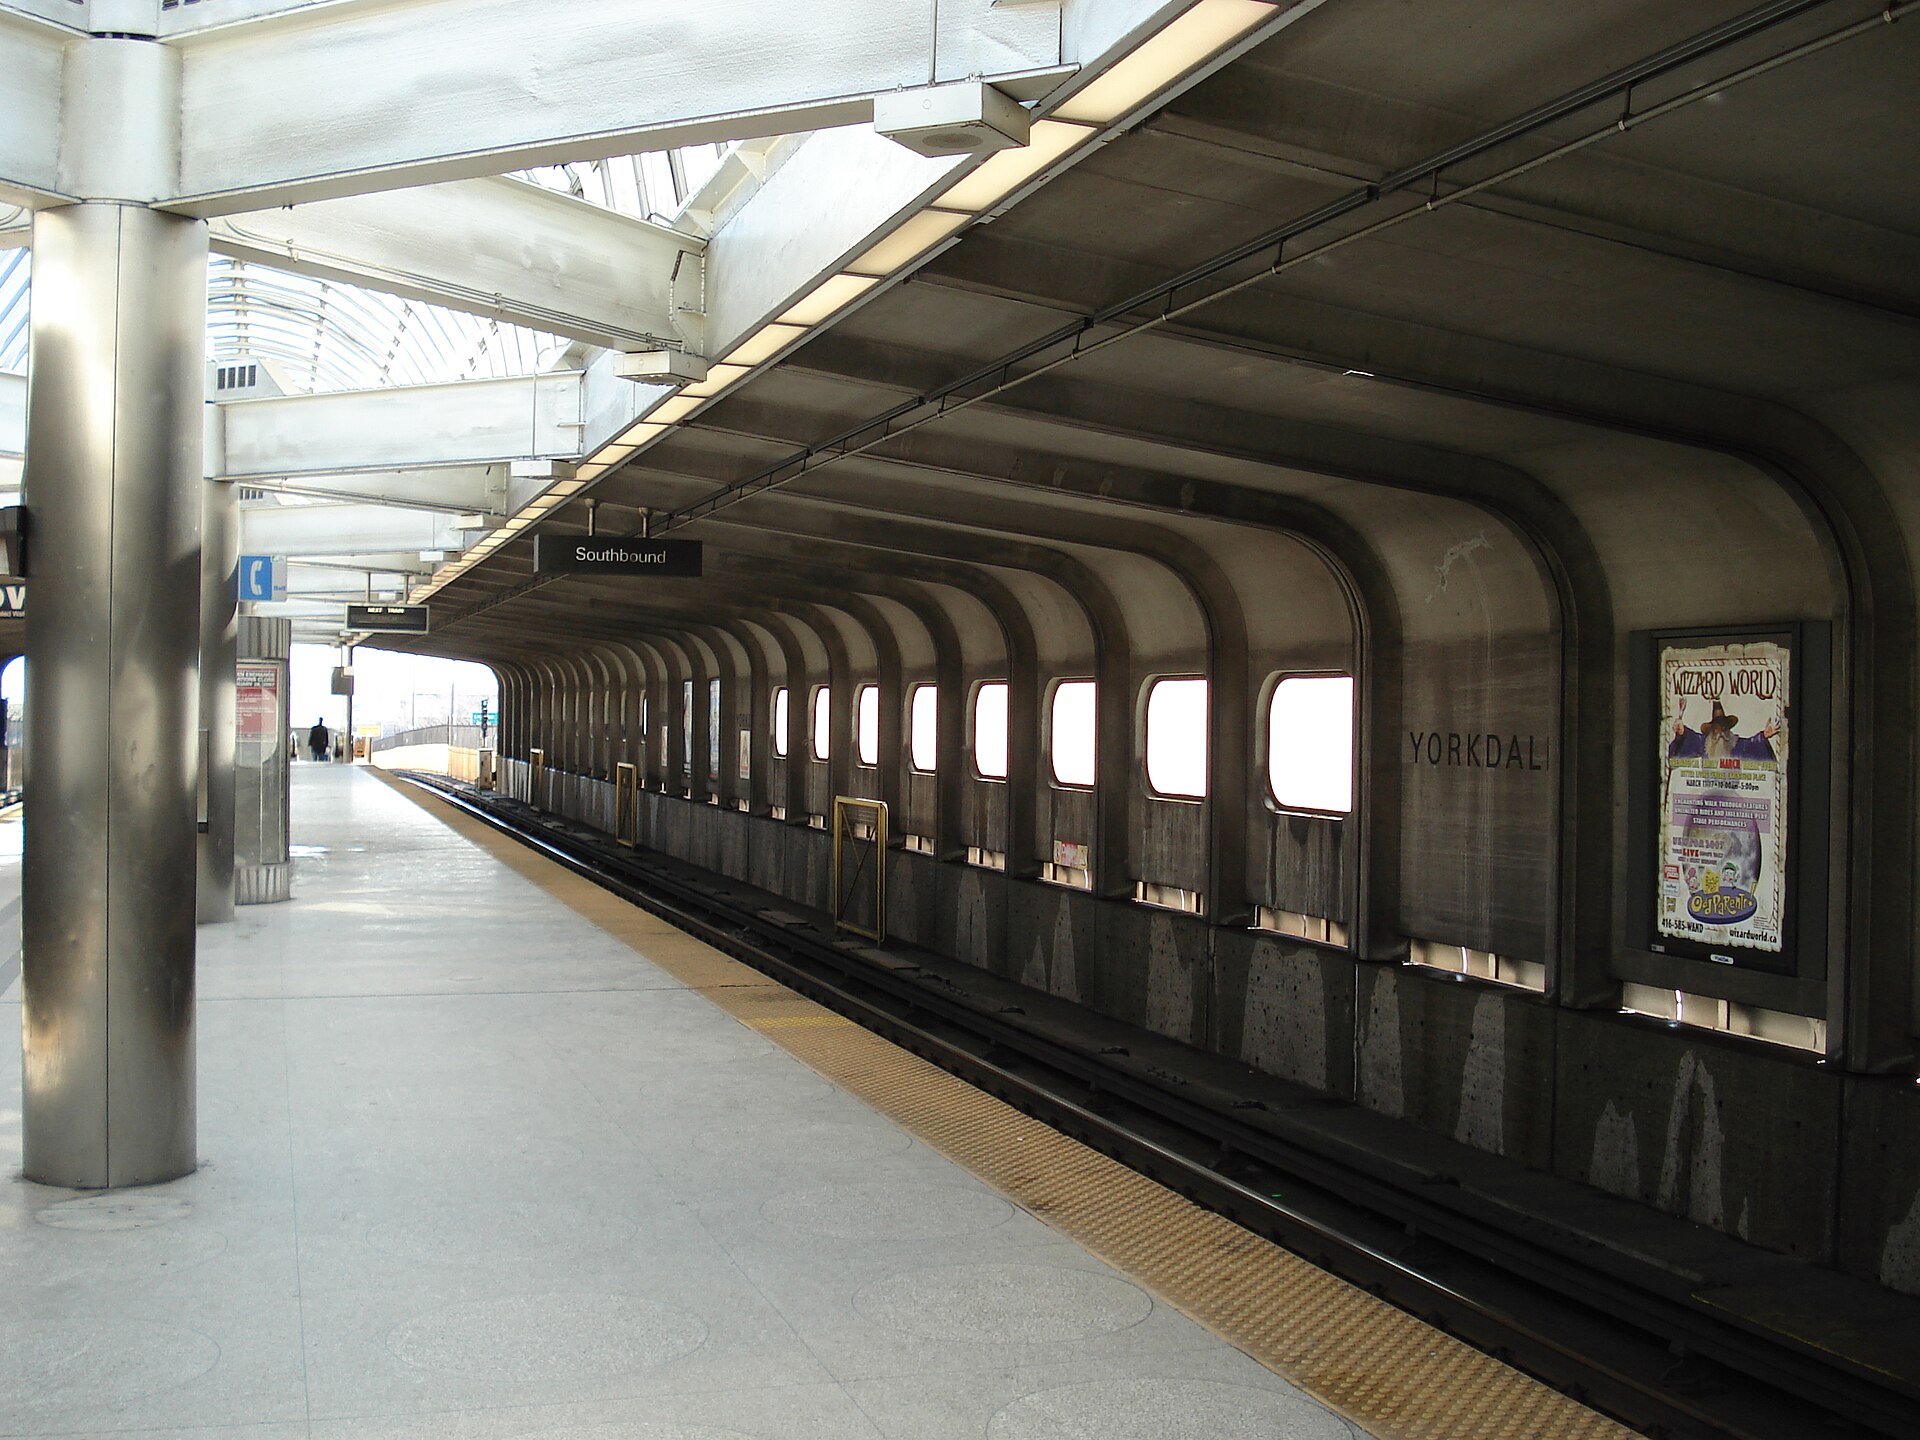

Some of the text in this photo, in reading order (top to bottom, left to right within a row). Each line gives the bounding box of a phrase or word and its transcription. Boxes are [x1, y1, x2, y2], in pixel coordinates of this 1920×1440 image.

[575, 546, 666, 563] Southbound
[1672, 669, 1777, 700] WIZARD WORLD
[1409, 731, 1550, 771] YORKDAL
[1682, 848, 1699, 857] LIVE
[1729, 927, 1777, 943] wizardworld.ca
